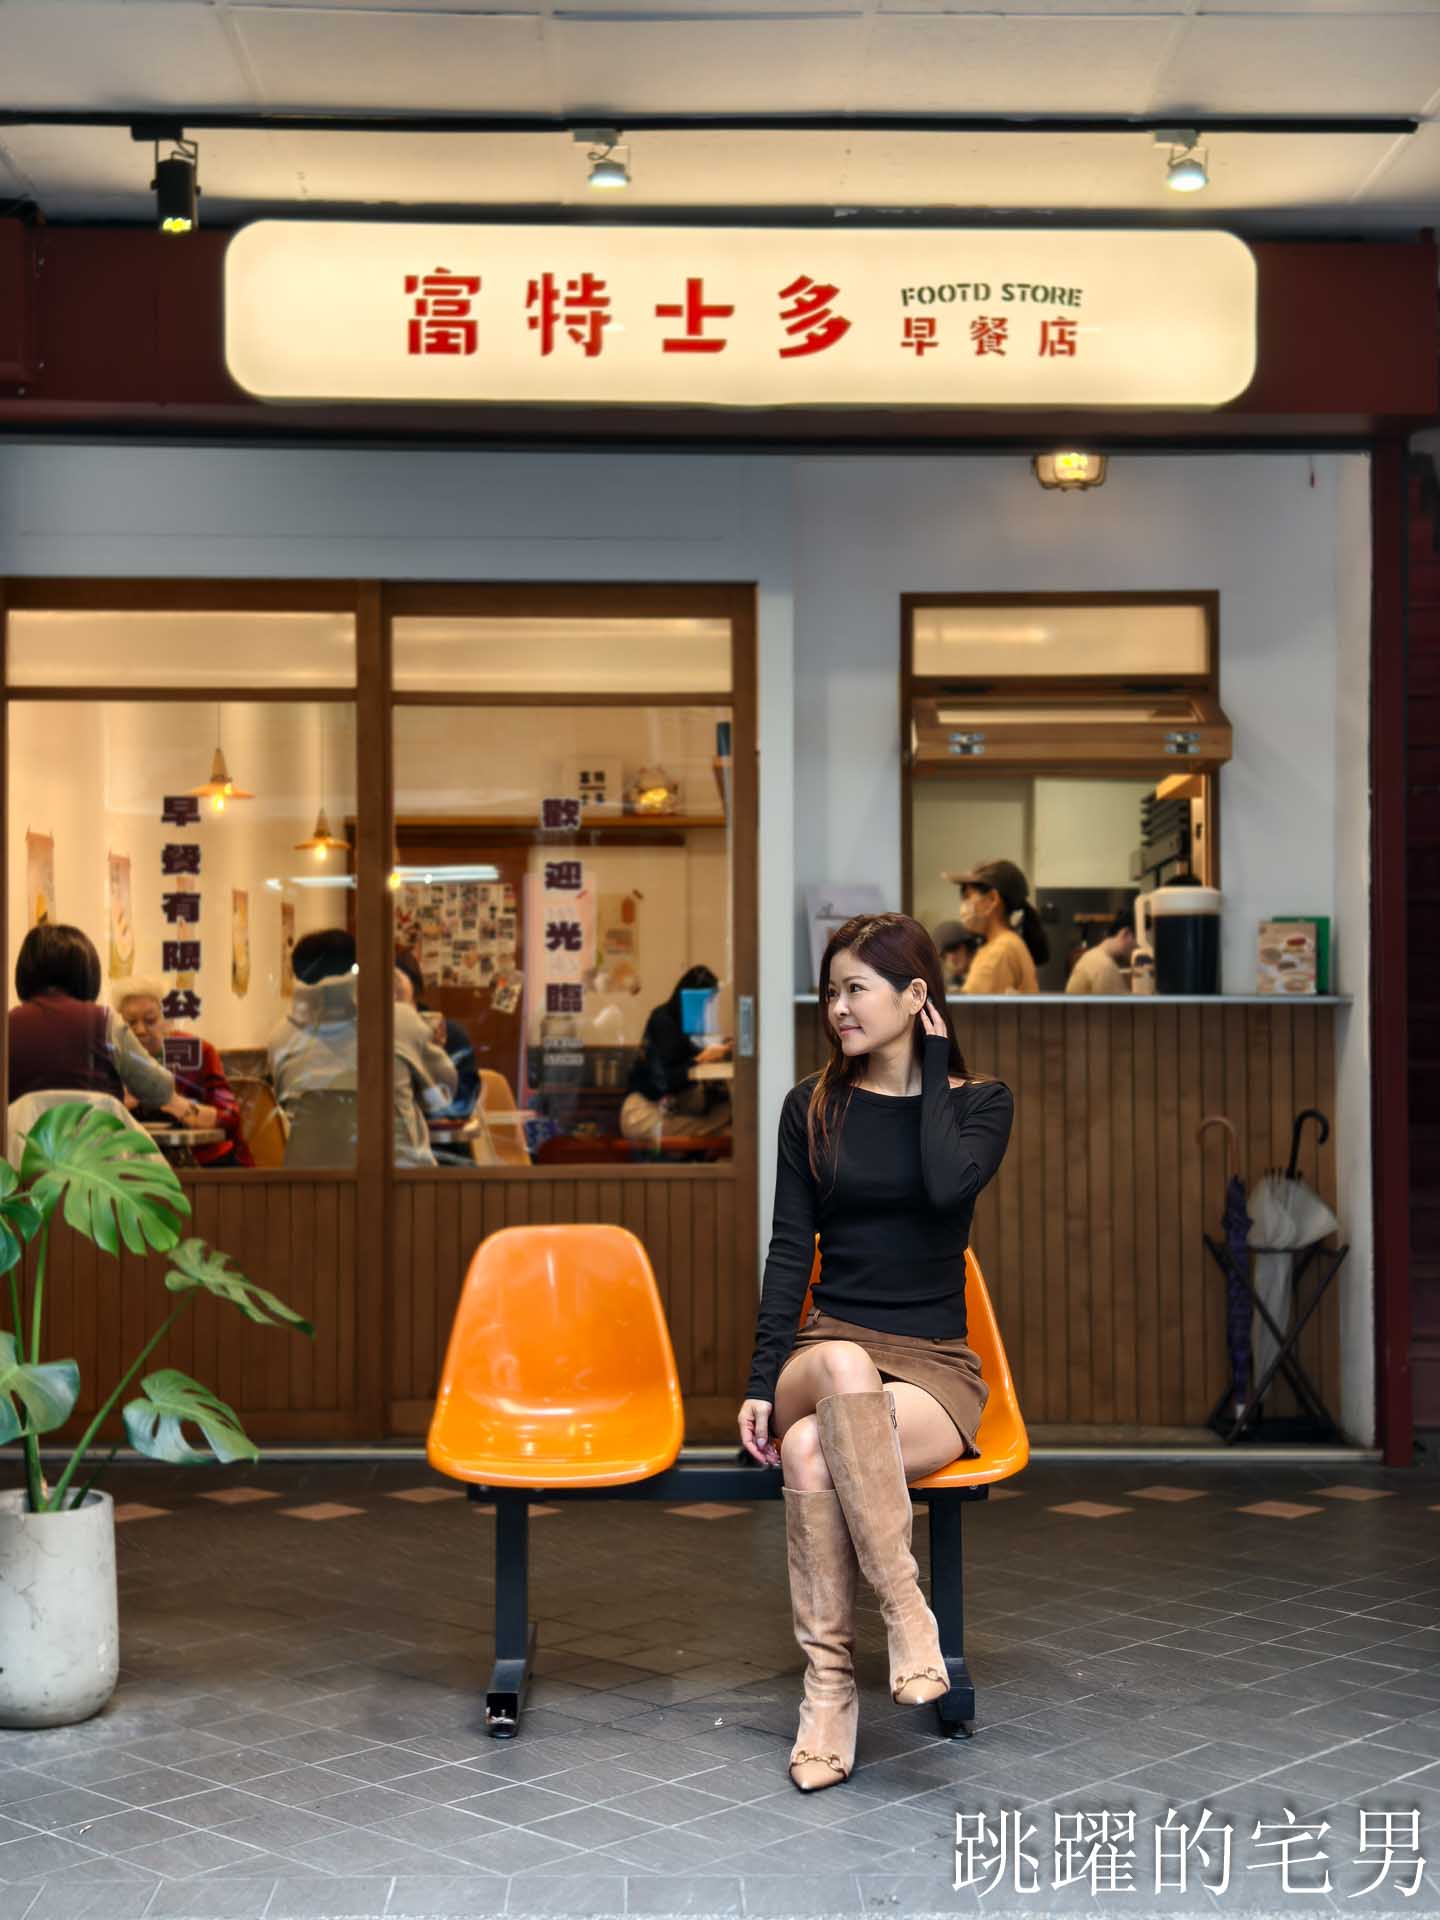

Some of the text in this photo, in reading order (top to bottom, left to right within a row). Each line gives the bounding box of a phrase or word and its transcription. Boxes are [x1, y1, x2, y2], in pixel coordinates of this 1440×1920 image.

[404, 267, 852, 359] 富特士多
[901, 283, 1083, 307] FOOTD STORE
[900, 316, 1078, 357] 早餐店
